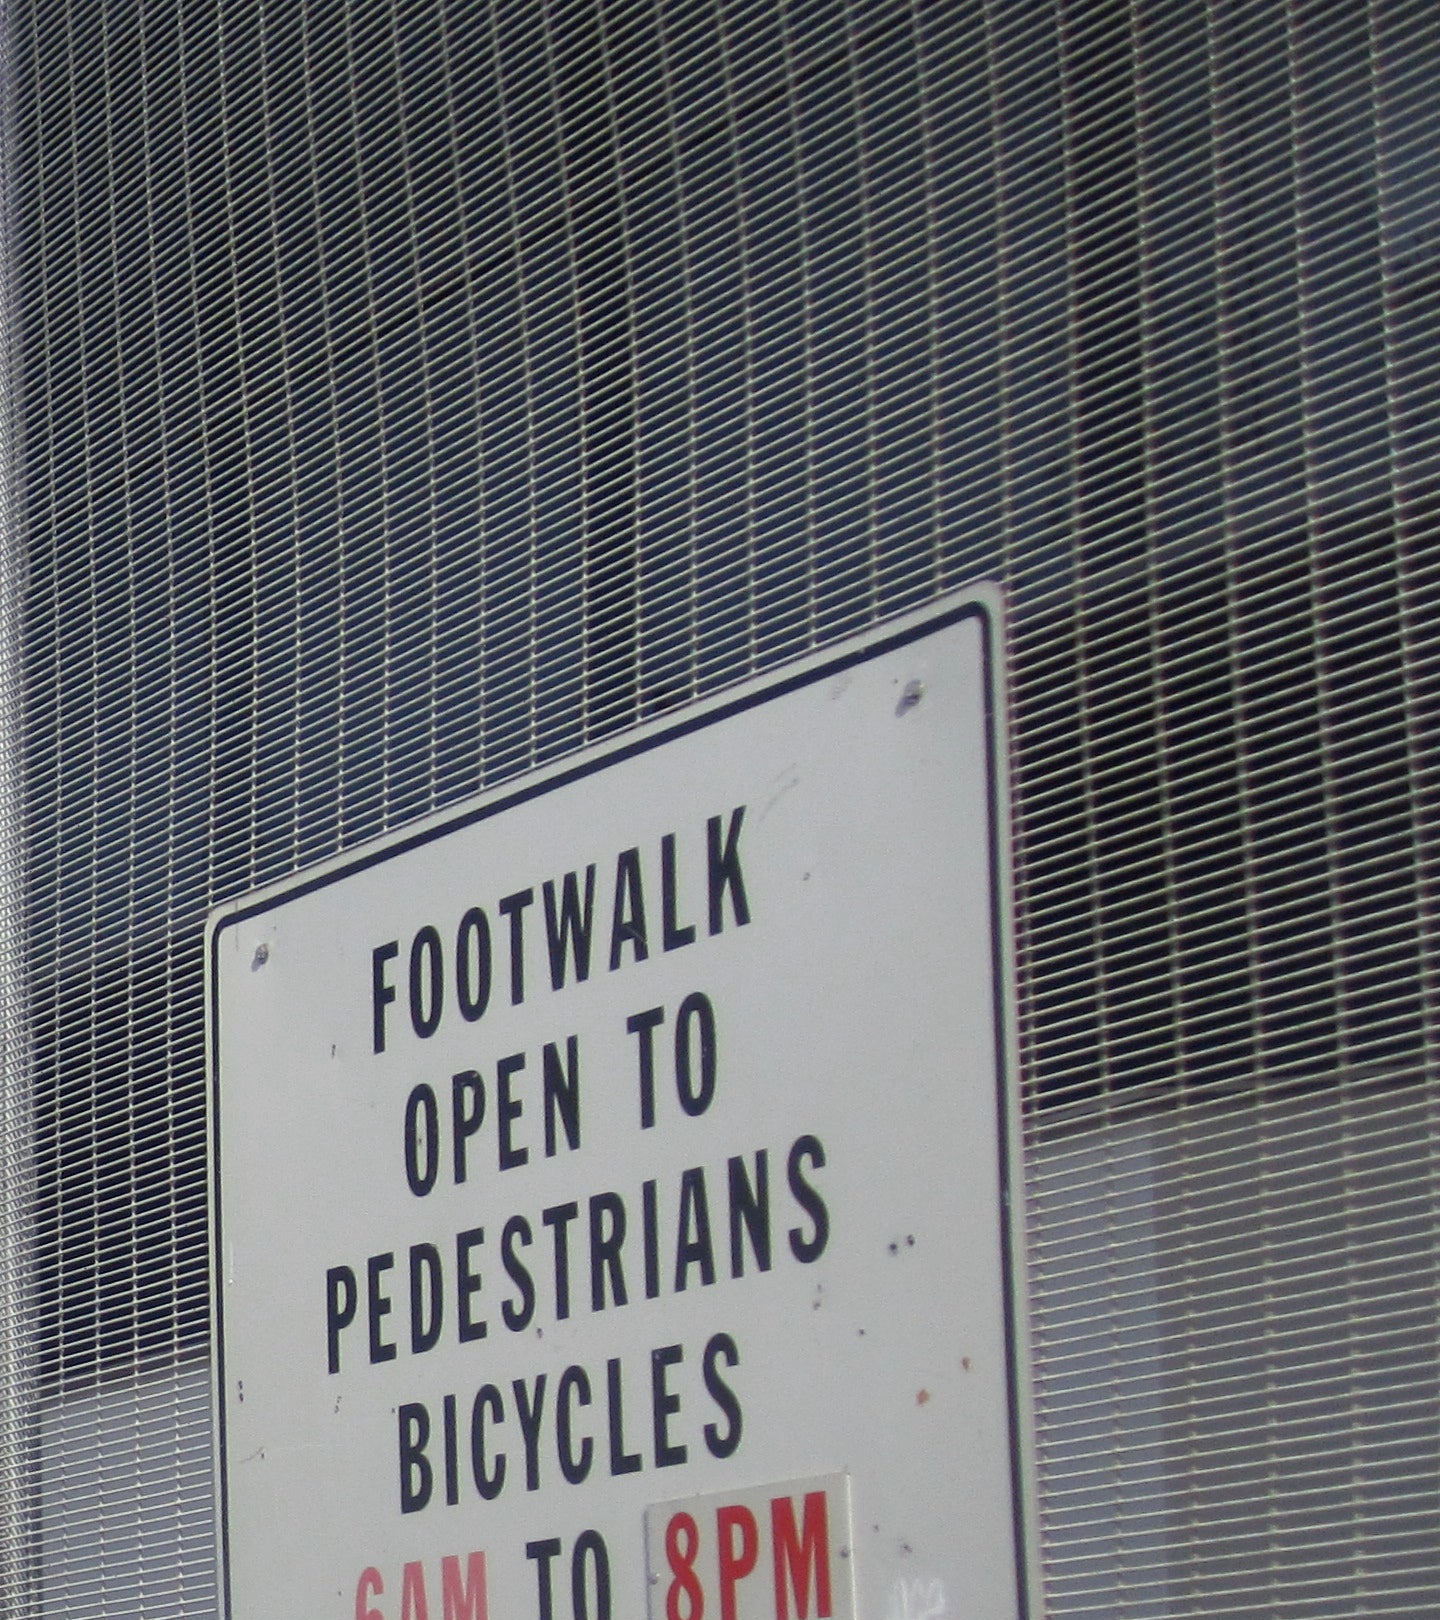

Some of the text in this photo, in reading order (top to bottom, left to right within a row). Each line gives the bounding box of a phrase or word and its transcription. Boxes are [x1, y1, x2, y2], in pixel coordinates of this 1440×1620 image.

[373, 806, 750, 1054] FOOTWALK
[405, 992, 716, 1197] OPEN TO
[326, 1135, 829, 1375] PEDESTRIANS
[399, 1333, 742, 1514] BICYCLES
